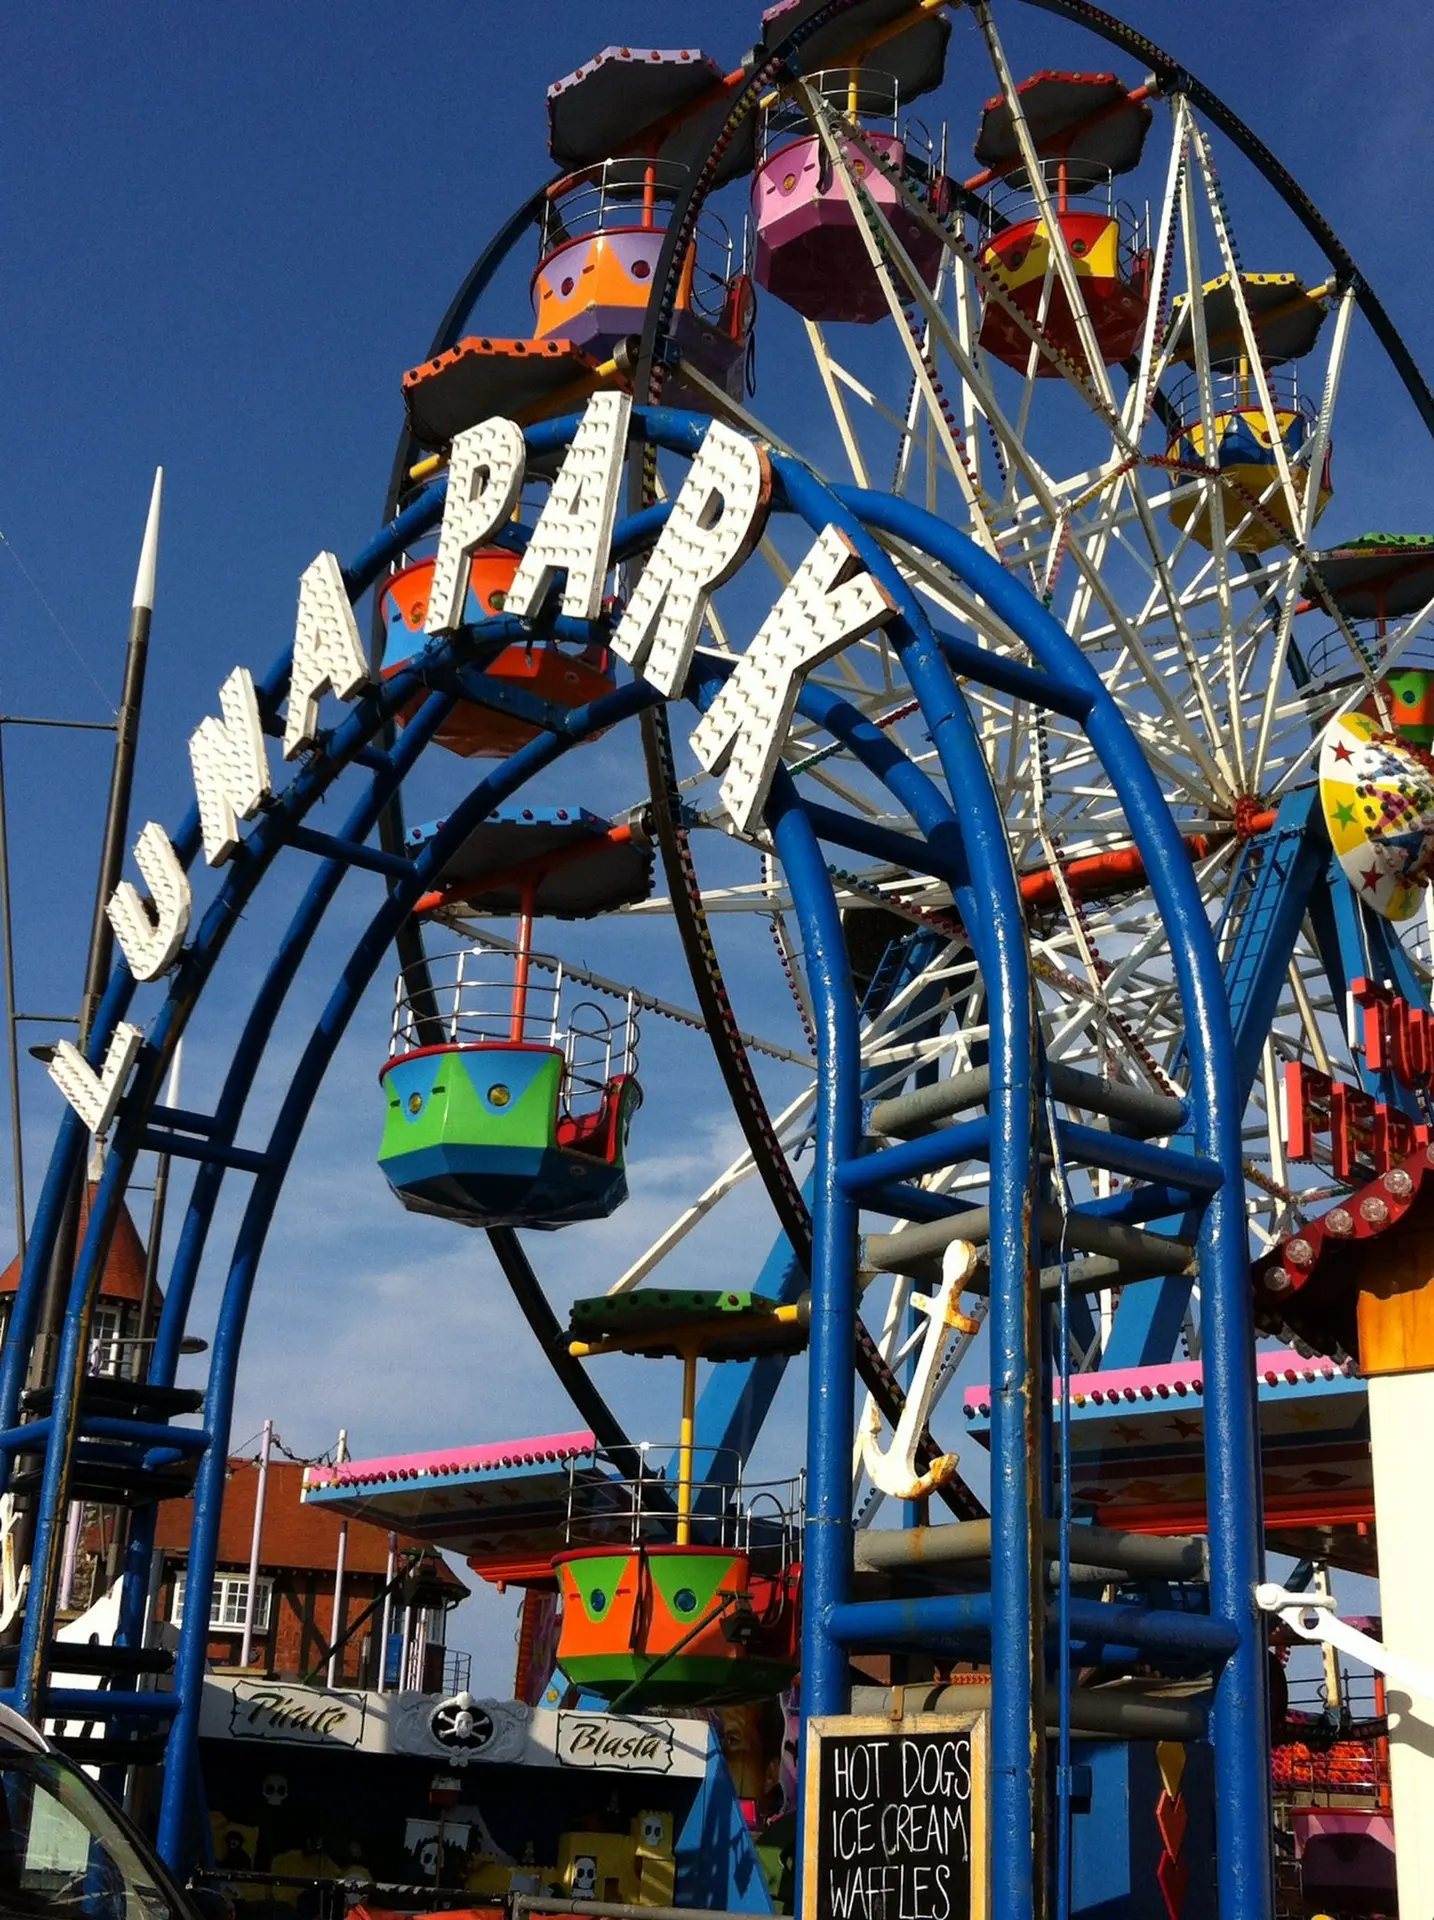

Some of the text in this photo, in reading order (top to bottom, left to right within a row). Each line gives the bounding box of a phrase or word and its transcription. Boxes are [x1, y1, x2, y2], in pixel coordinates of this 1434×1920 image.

[47, 390, 898, 1133] LUNA PARK
[248, 1692, 662, 1760] Pirate Blasta
[834, 1740, 971, 1800] HOT DOGS
[832, 1803, 968, 1862] ICE CREAM
[830, 1864, 950, 1920] WAFFLES
